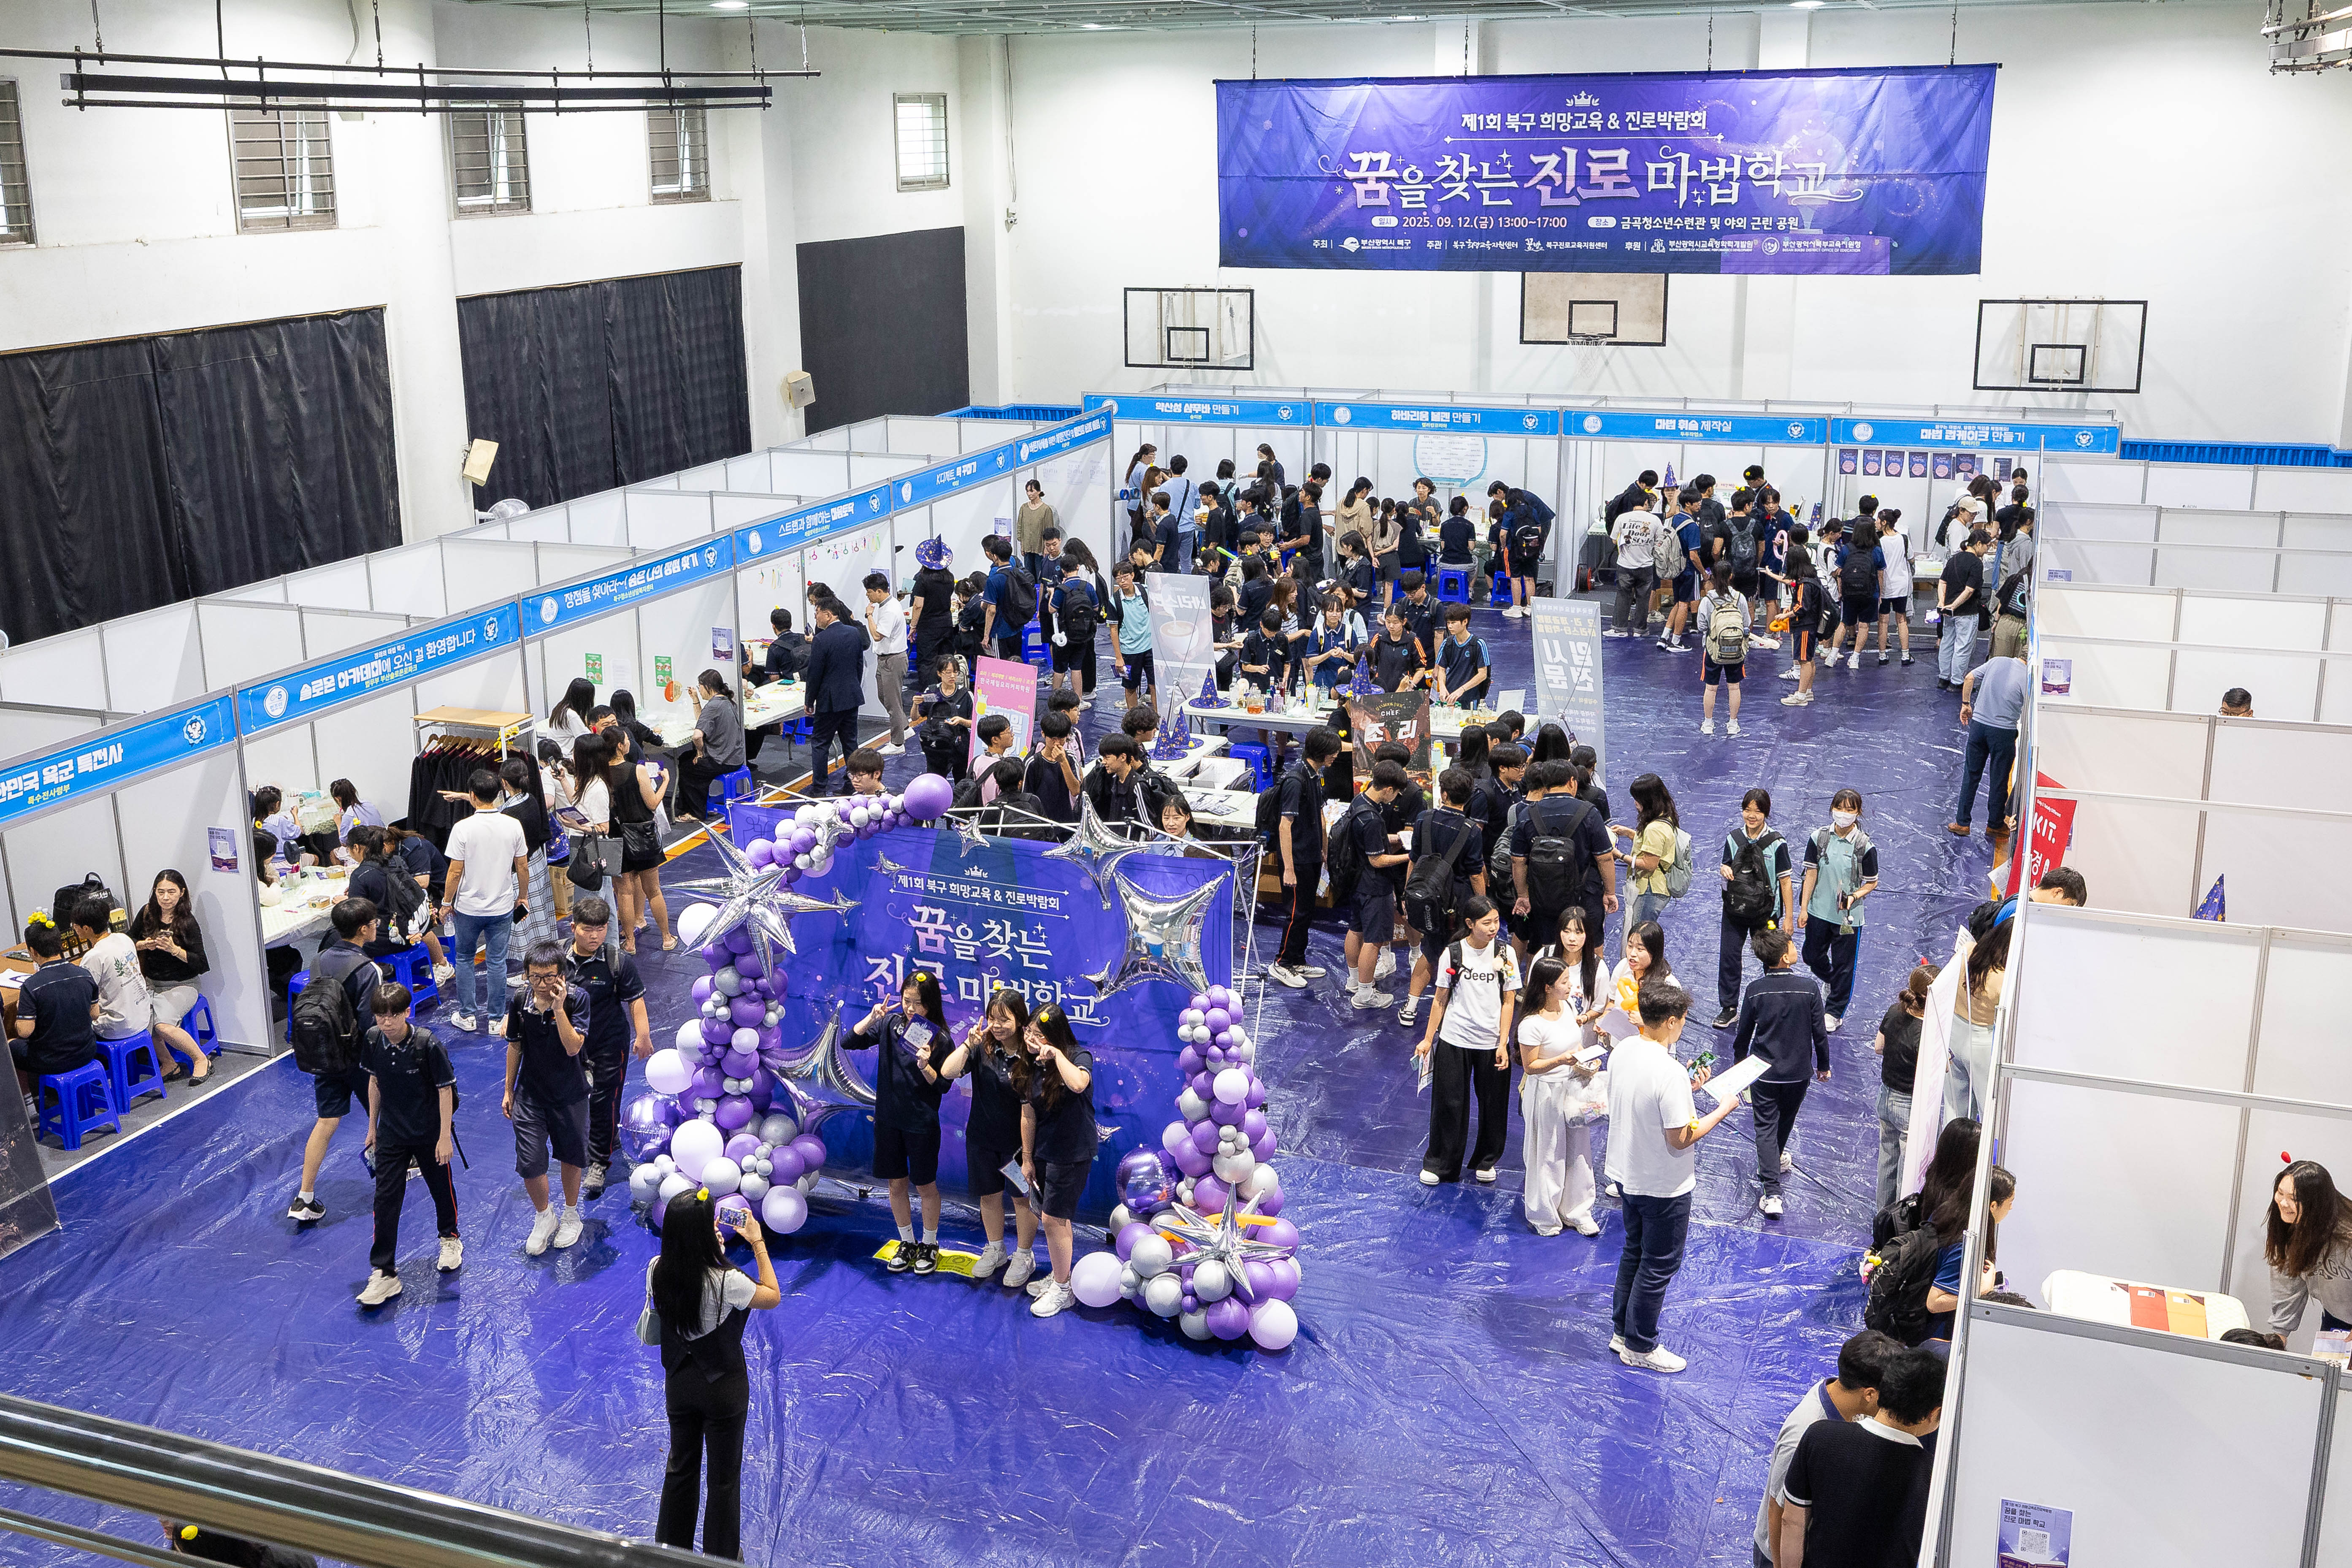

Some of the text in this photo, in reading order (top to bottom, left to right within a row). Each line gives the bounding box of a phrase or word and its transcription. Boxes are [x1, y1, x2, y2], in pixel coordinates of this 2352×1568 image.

[1462, 110, 1707, 133] 제1회 북구 희망교육 & 진로박람회
[1343, 145, 1836, 209] 꿈을 찾는 진로 마법학교
[1402, 216, 1433, 228] 2025.
[1436, 216, 1453, 228] 09.
[1457, 216, 1494, 229] 12.(금)
[1498, 216, 1567, 228] 13:00~17:00
[1595, 216, 1799, 230] 장소 금곡청소년수련관 및 야외 근린 공원
[1313, 239, 1328, 249] 주최
[1426, 240, 1442, 249] 주관
[1467, 238, 1518, 249] 희망교육지원센터
[1546, 241, 1608, 250] 북구진로교육지원센터
[1624, 241, 1641, 251] 후원
[1155, 402, 1240, 415] 약산성 샴푸바 만들기
[1391, 409, 1481, 424] 하바리움 볼펜 만들기
[1655, 418, 1676, 431] 마법
[1700, 420, 1732, 432] 제작실
[1920, 428, 2025, 443] 마법 컵케이크 만들기
[779, 517, 806, 537] 스트랩과
[805, 509, 831, 528] 함께하는
[563, 587, 592, 609] 장점을
[299, 628, 476, 701] 솔로몬 아카데미에 오신 걸 환영합니다
[42, 758, 75, 785] 육군
[76, 742, 125, 775] 특전사
[27, 783, 71, 805] 특수전사령부
[897, 873, 1060, 911] 제1회 북구 희망교육 & 진로박람회
[908, 904, 1053, 970] 꿈을 찾는
[1463, 969, 1495, 983] Jeep
[2004, 1507, 2032, 1518] 꿈을 찾는
[2004, 1515, 2017, 1524] 진로
[2018, 1517, 2031, 1525] 마법
[2033, 1519, 2046, 1528] 학교
